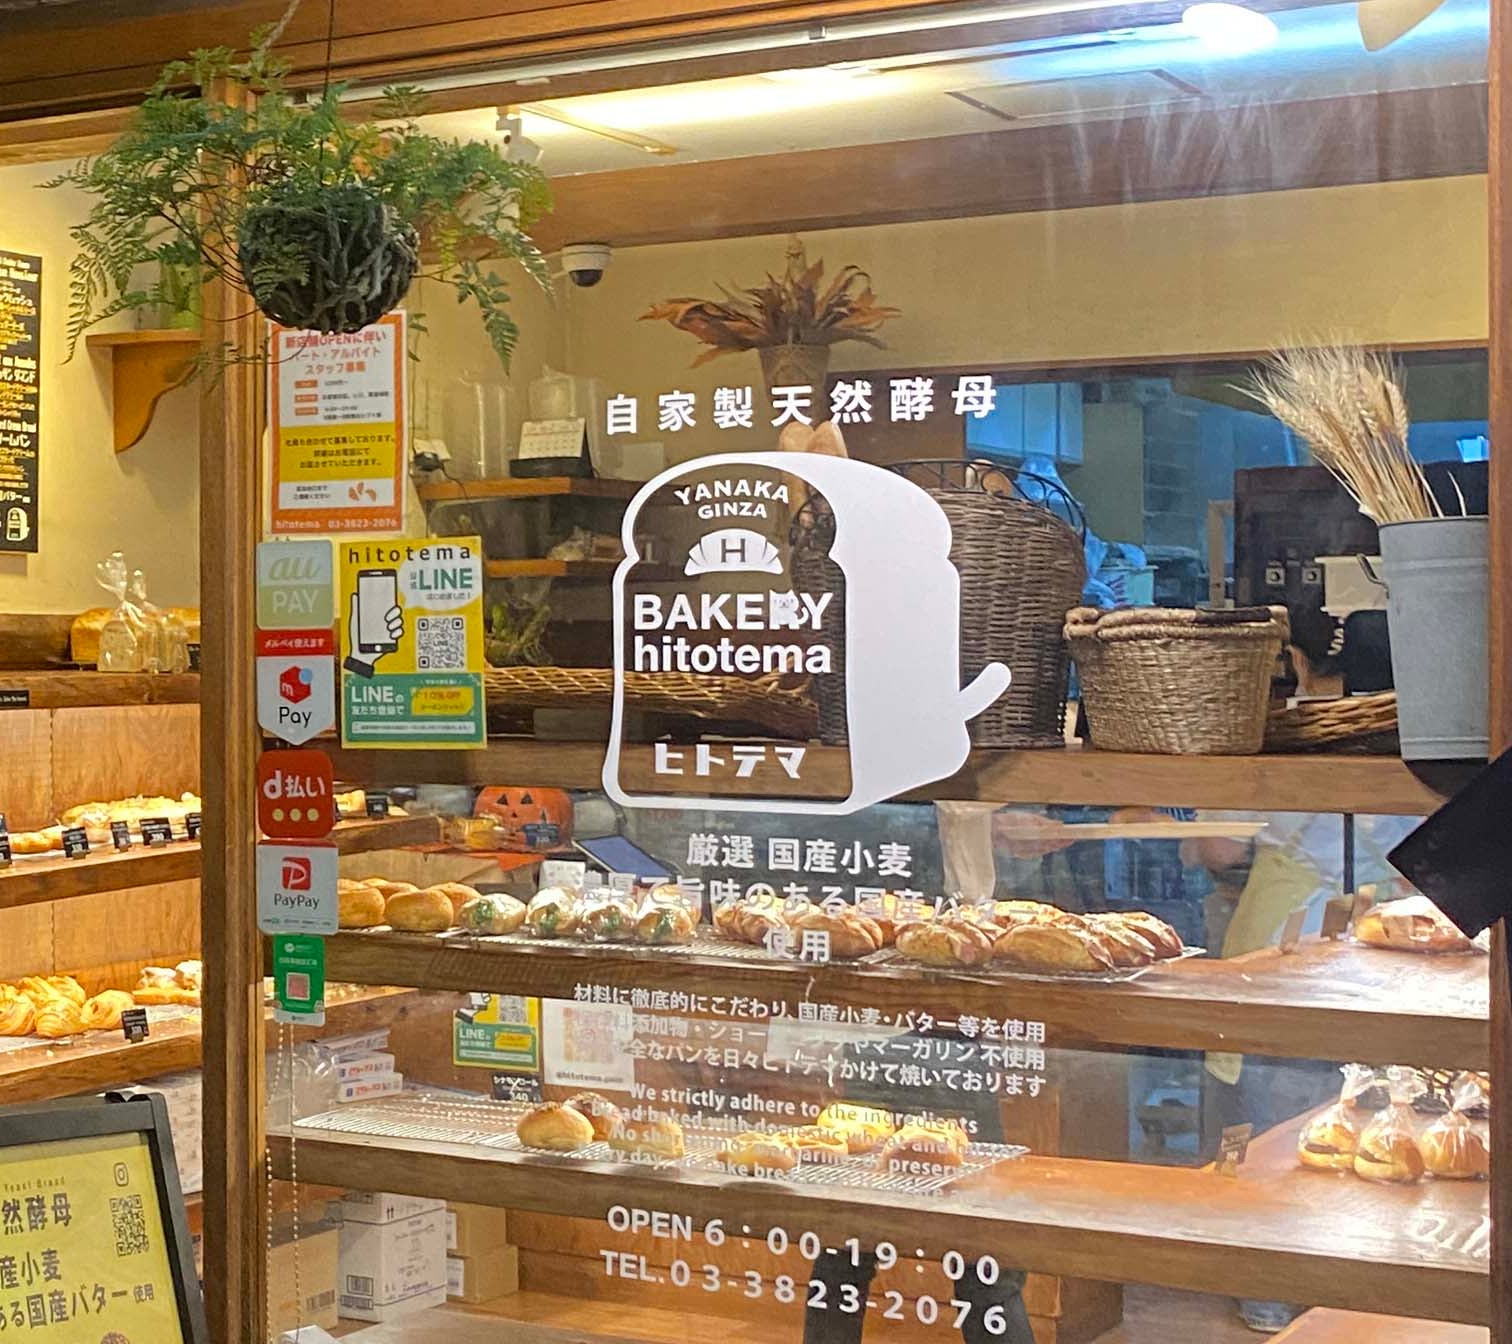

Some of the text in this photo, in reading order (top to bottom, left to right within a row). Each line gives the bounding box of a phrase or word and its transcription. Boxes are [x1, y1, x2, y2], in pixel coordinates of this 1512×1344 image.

[605, 375, 999, 436] 自家製天然酵母
[674, 479, 790, 506] YANAKA
[697, 502, 768, 519] GINZA
[268, 556, 321, 581] au
[348, 545, 471, 564] hitotema
[418, 567, 473, 591] LINE
[272, 589, 319, 614] PAY
[633, 590, 834, 631] BAKERY
[633, 636, 832, 674] hitotema
[278, 706, 313, 728] Pay
[654, 743, 806, 780] ヒトテマ
[263, 769, 326, 800] d払い
[685, 832, 913, 878] 厳選 国産小麦
[273, 893, 320, 910] PayPay
[763, 927, 831, 963] 使用
[630, 1082, 657, 1101] We
[661, 1087, 727, 1112] strictly
[730, 1093, 796, 1115] adhere
[800, 1101, 821, 1118] to
[825, 1103, 860, 1121] the
[606, 1204, 694, 1243] OPEN
[133, 1283, 156, 1303] 使用
